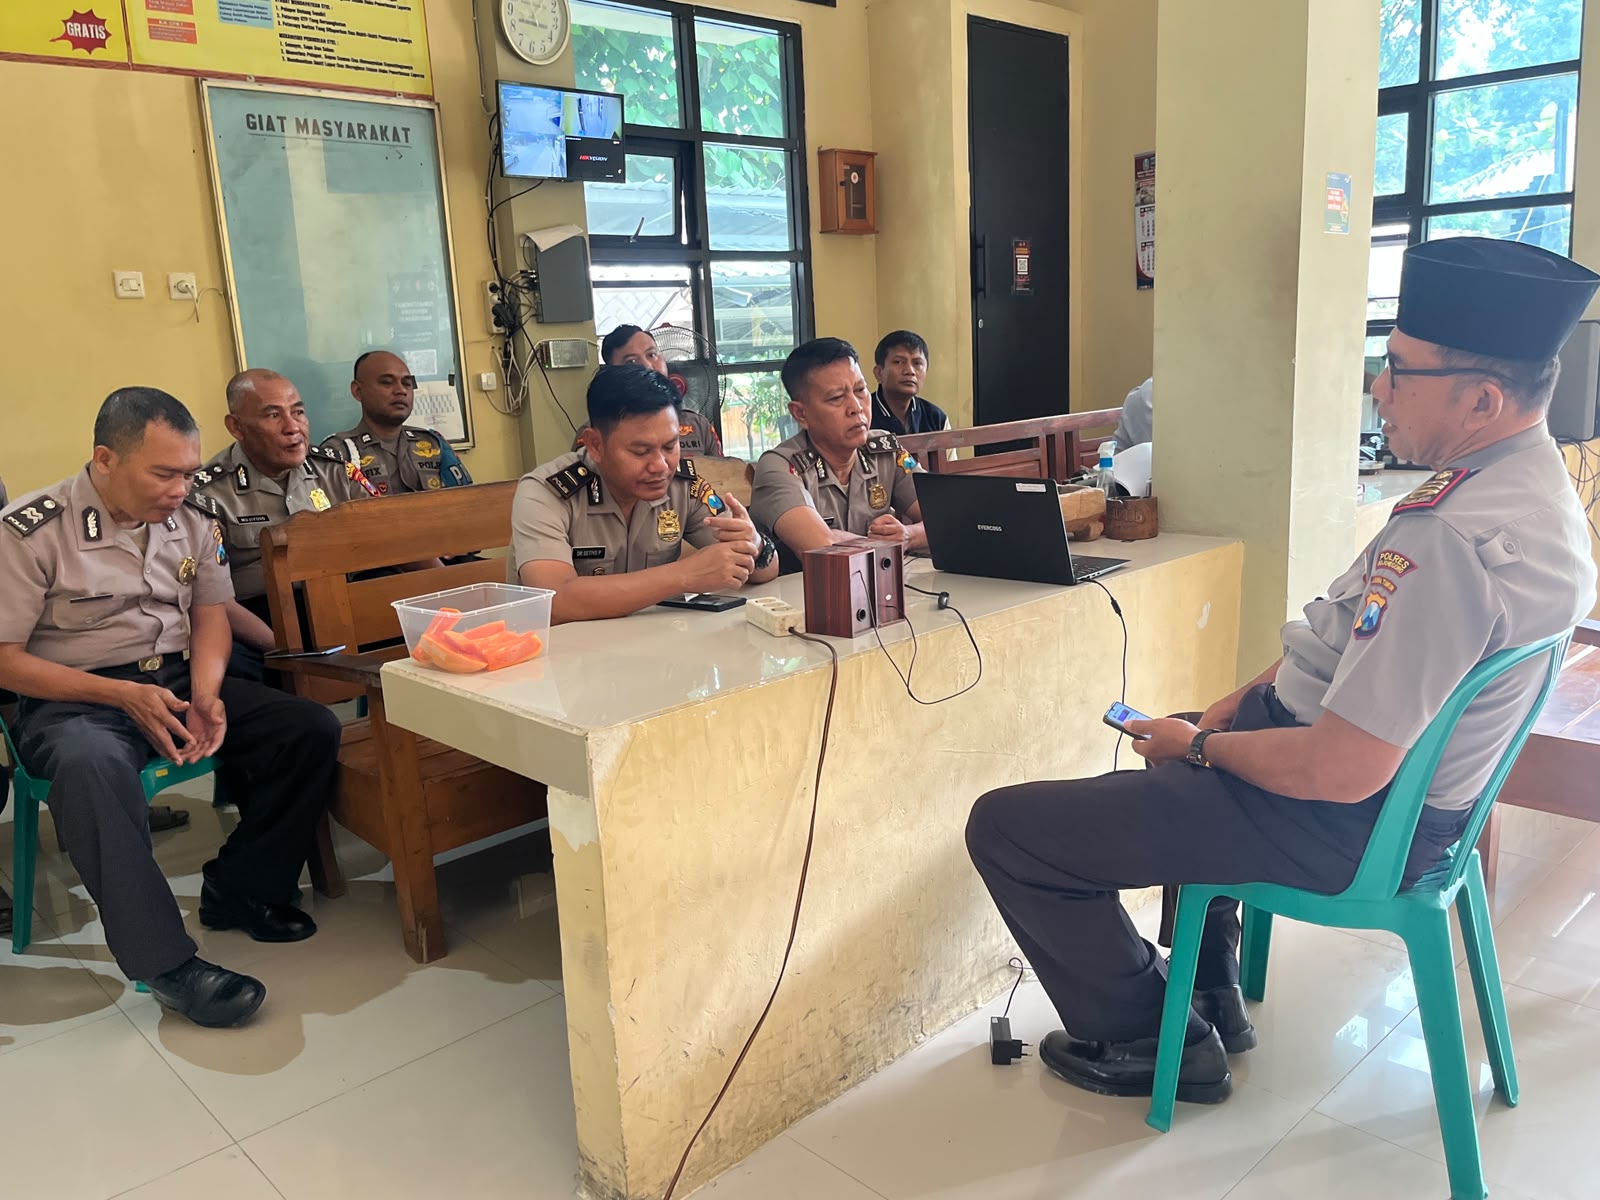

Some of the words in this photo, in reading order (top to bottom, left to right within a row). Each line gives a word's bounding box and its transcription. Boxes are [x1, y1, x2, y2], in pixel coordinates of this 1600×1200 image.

[66, 22, 106, 40] GRATIS
[246, 113, 286, 132] GIAT
[295, 117, 411, 144] MASYARAKAT
[680, 440, 700, 448] OLRI
[1380, 552, 1410, 570] POLRES
